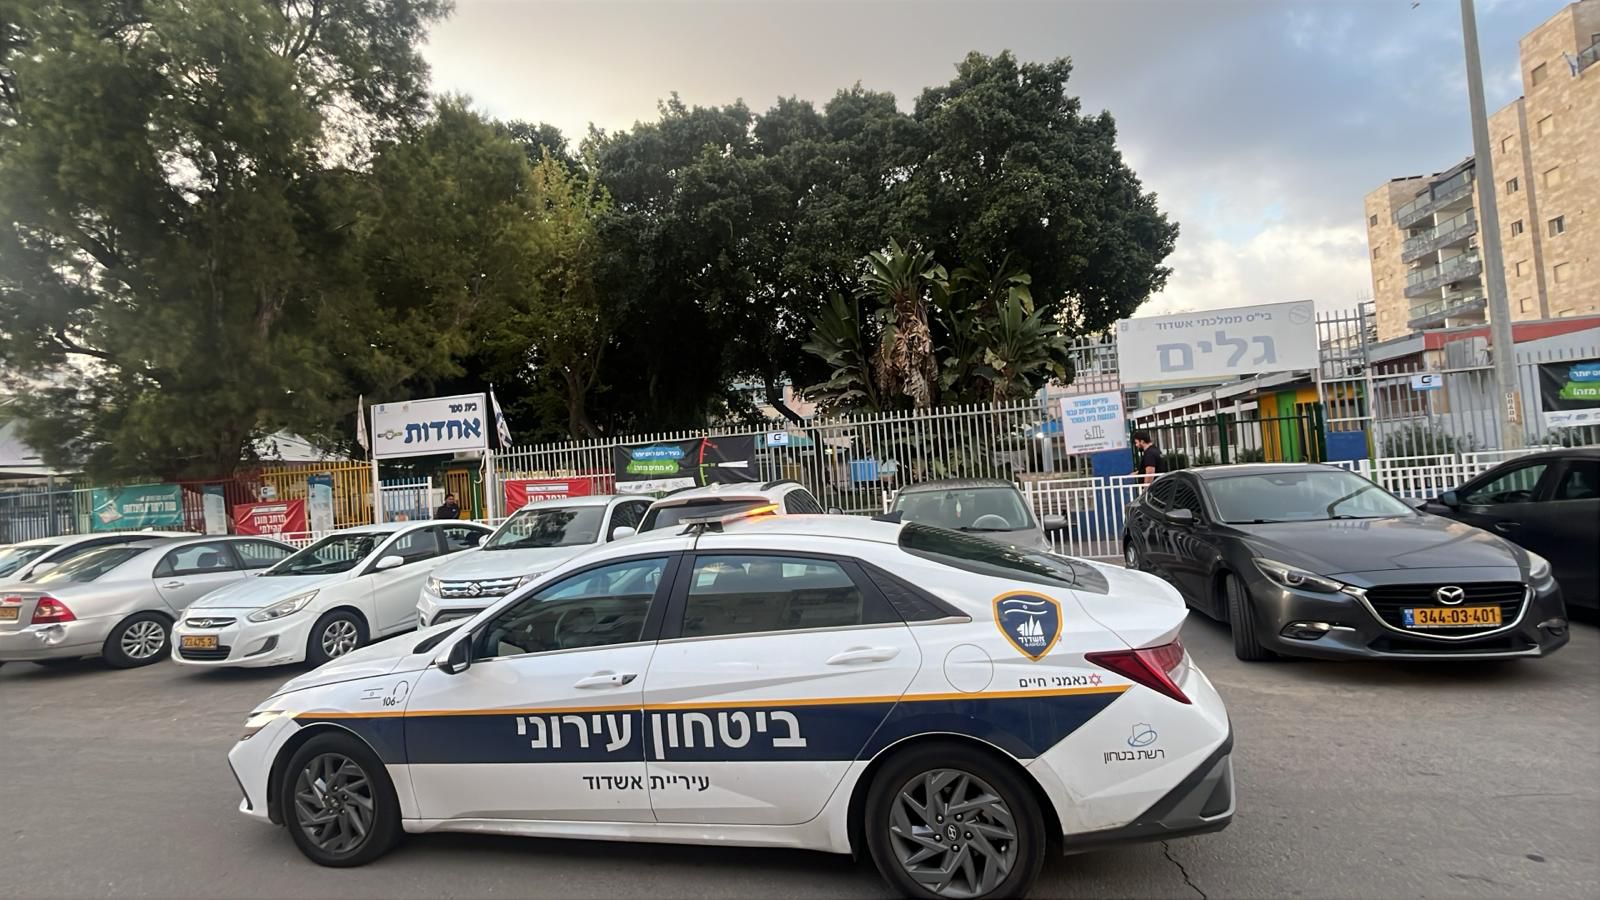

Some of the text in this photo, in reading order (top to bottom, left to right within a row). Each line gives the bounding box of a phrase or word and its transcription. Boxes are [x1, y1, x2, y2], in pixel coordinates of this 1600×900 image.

[1155, 320, 1193, 331] אשדוד
[1197, 314, 1243, 327] ממלכתי
[1156, 330, 1277, 373] גלים
[448, 402, 478, 413] בית ספר
[404, 417, 481, 444] אחדות
[1419, 608, 1497, 623] 344-03-401
[1018, 636, 1045, 644] אשדוד
[1019, 675, 1088, 688] נאמני חיים
[383, 696, 395, 706] 106
[516, 710, 807, 760] ביטחון עירוני
[1103, 749, 1165, 764] רשת בטחון
[582, 775, 710, 792] עיריית אשדוד
